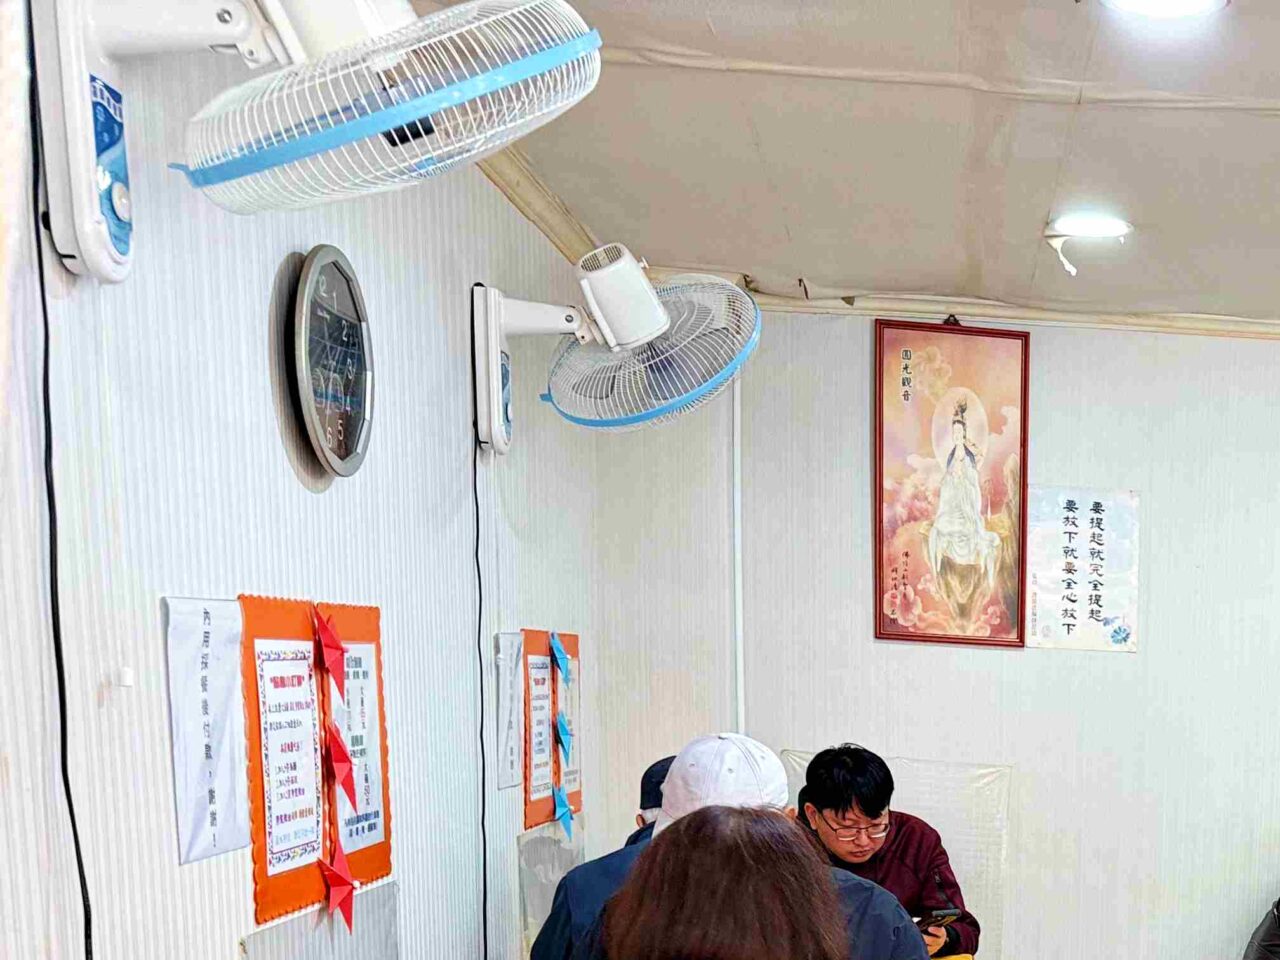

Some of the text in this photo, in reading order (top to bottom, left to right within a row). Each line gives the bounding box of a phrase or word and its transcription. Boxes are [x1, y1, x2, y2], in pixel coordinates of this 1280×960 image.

[1061, 499, 1079, 635] 要放下就要全心放下
[1088, 501, 1105, 622] 要提起就完全提起
